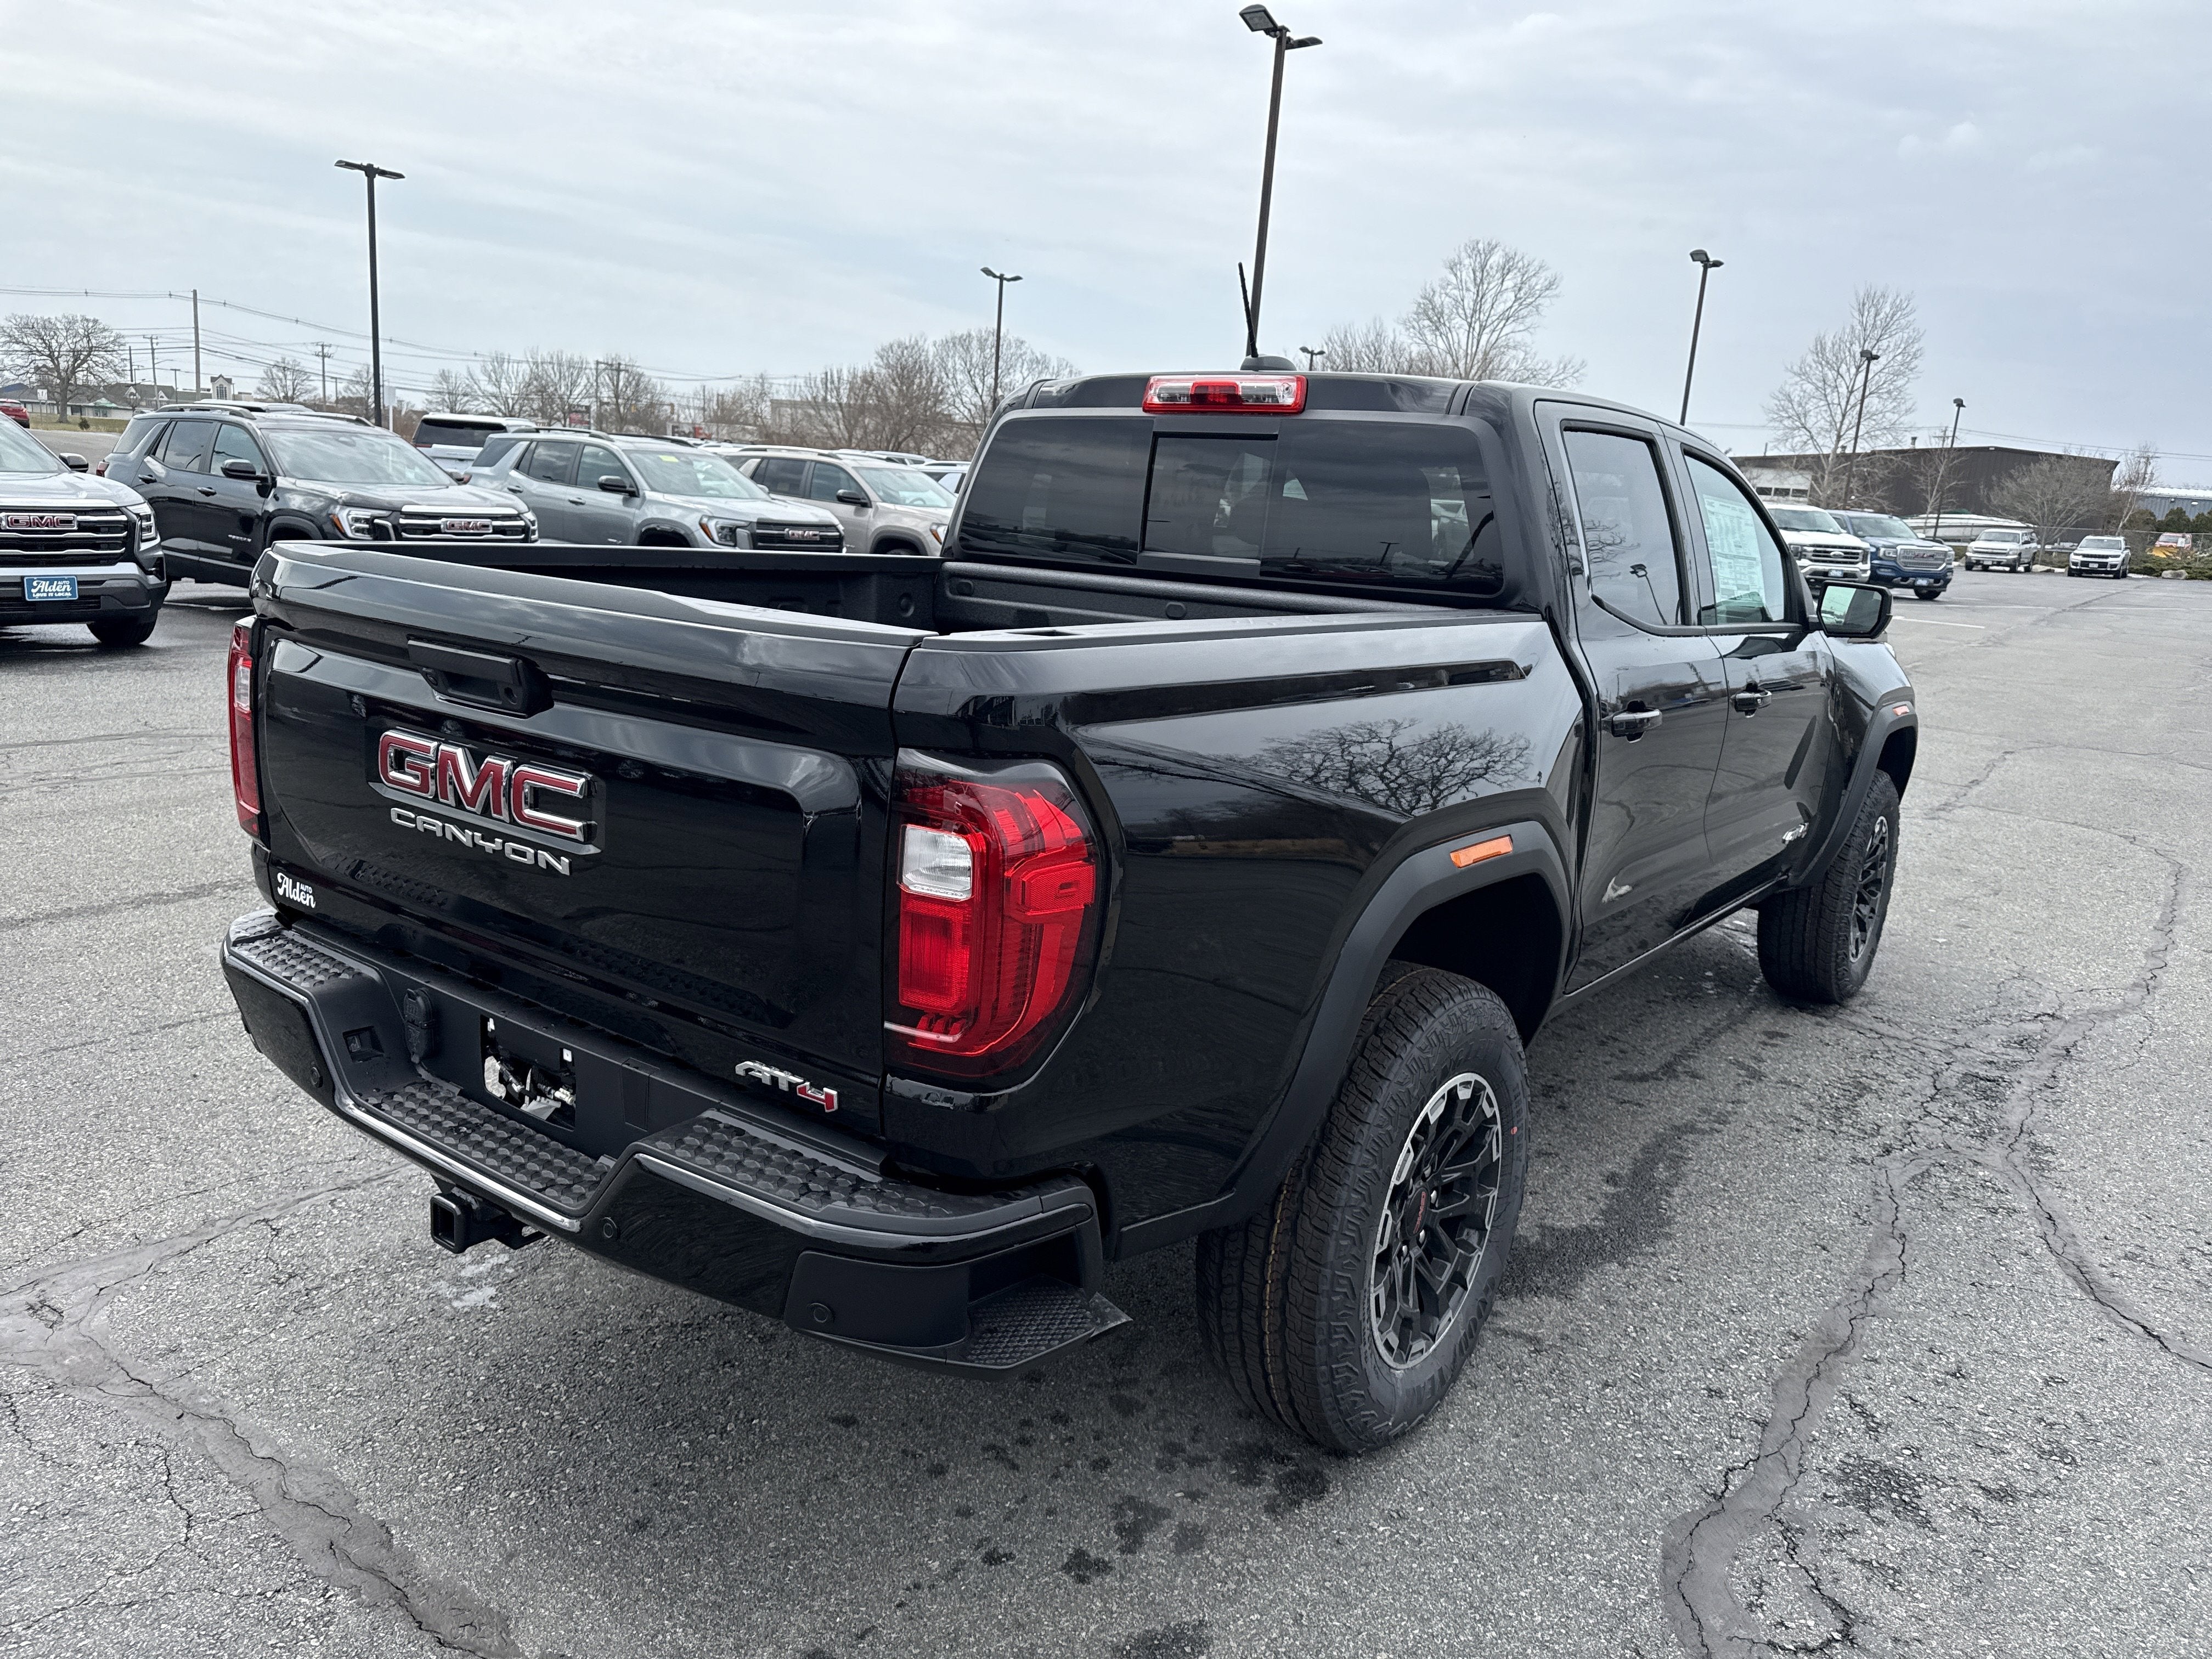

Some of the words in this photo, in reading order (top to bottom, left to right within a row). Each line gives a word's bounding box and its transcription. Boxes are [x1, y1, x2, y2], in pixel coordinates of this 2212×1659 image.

[8, 515, 74, 528] GMC
[447, 521, 492, 531] GMC
[31, 580, 72, 593] Alden
[379, 730, 587, 842] GMC
[391, 808, 572, 876] CANYON
[277, 872, 316, 908] Alden
[300, 883, 312, 894] AUTO
[735, 1061, 838, 1119] AT4
[1413, 1191, 1426, 1235] GMC
